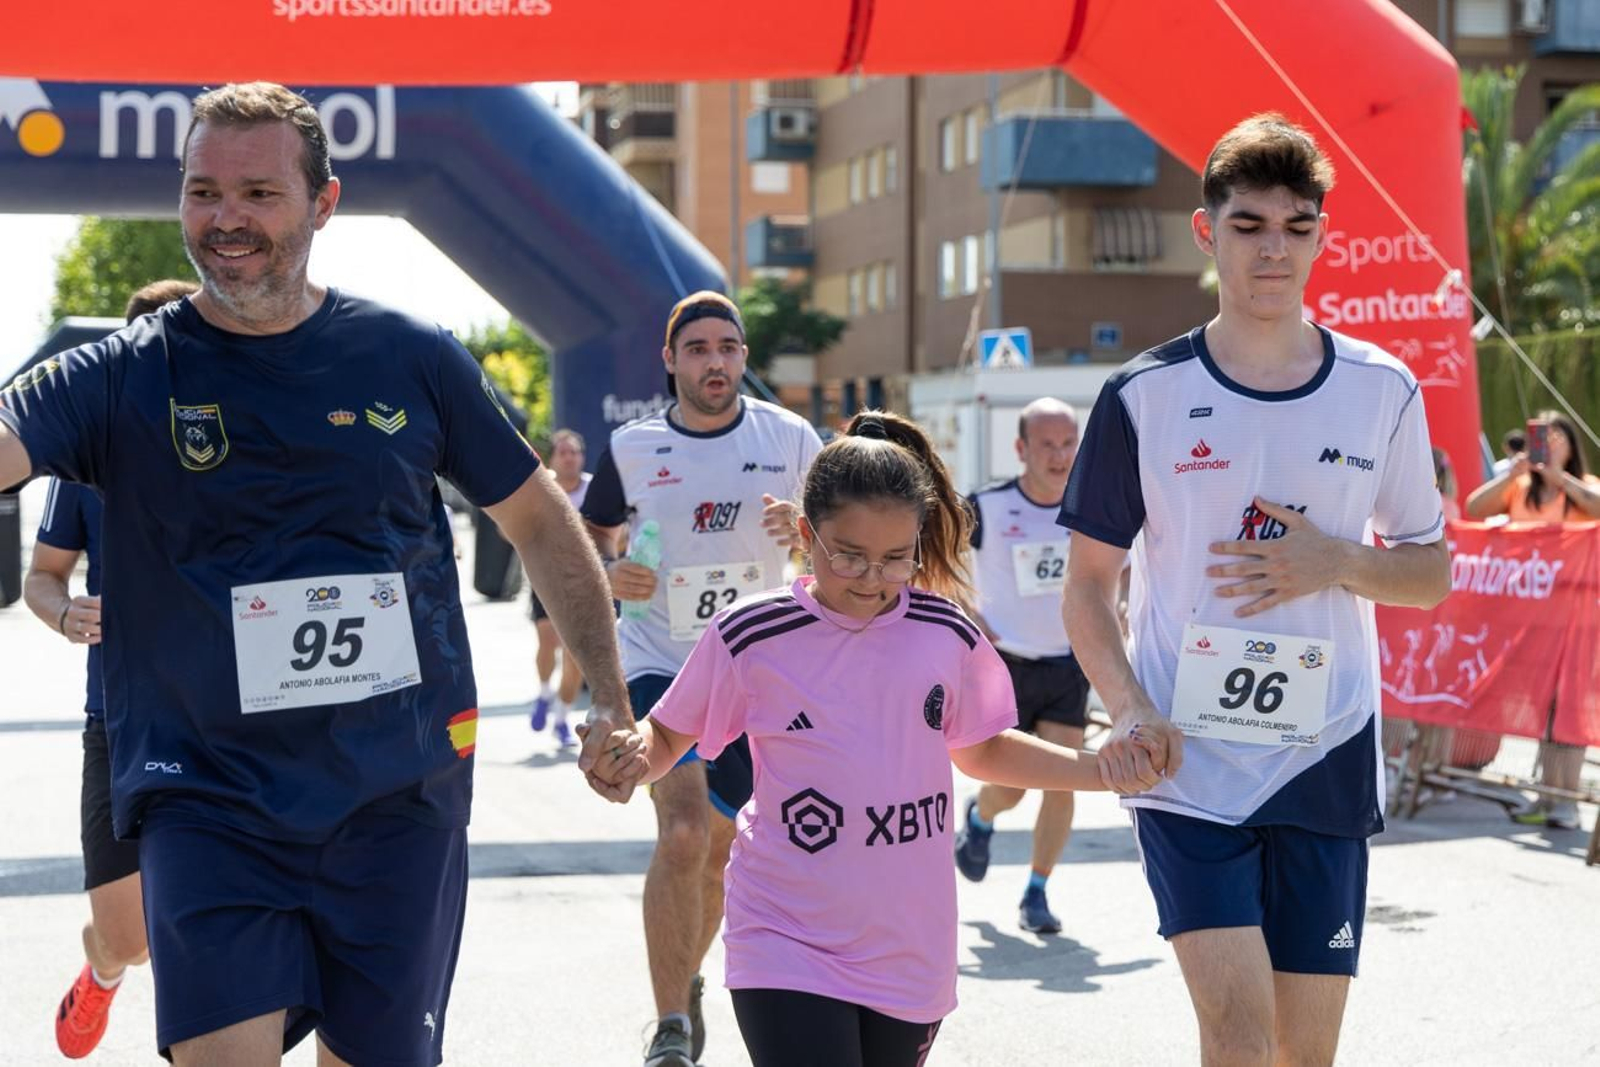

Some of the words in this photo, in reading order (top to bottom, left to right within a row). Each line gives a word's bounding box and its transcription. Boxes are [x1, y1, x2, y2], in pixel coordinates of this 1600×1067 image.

[272, 0, 551, 22] sportssantander.es
[100, 85, 396, 161] mol
[1325, 231, 1435, 274] Sports
[602, 393, 677, 423] fund
[1174, 459, 1231, 474] Santander
[1347, 455, 1375, 472] mupol
[1036, 558, 1065, 580] 62
[1448, 540, 1564, 600] antander
[290, 616, 366, 672] 95
[279, 678, 312, 690] ANTONIO
[313, 675, 351, 687] ABOLAFIA
[351, 672, 382, 684] MONTES
[1219, 667, 1289, 714] 96
[1198, 713, 1228, 724] ANTONIO
[1228, 716, 1260, 728] ABOLAFIA
[1260, 719, 1298, 732] COLMENERO
[865, 792, 948, 847] XBTO
